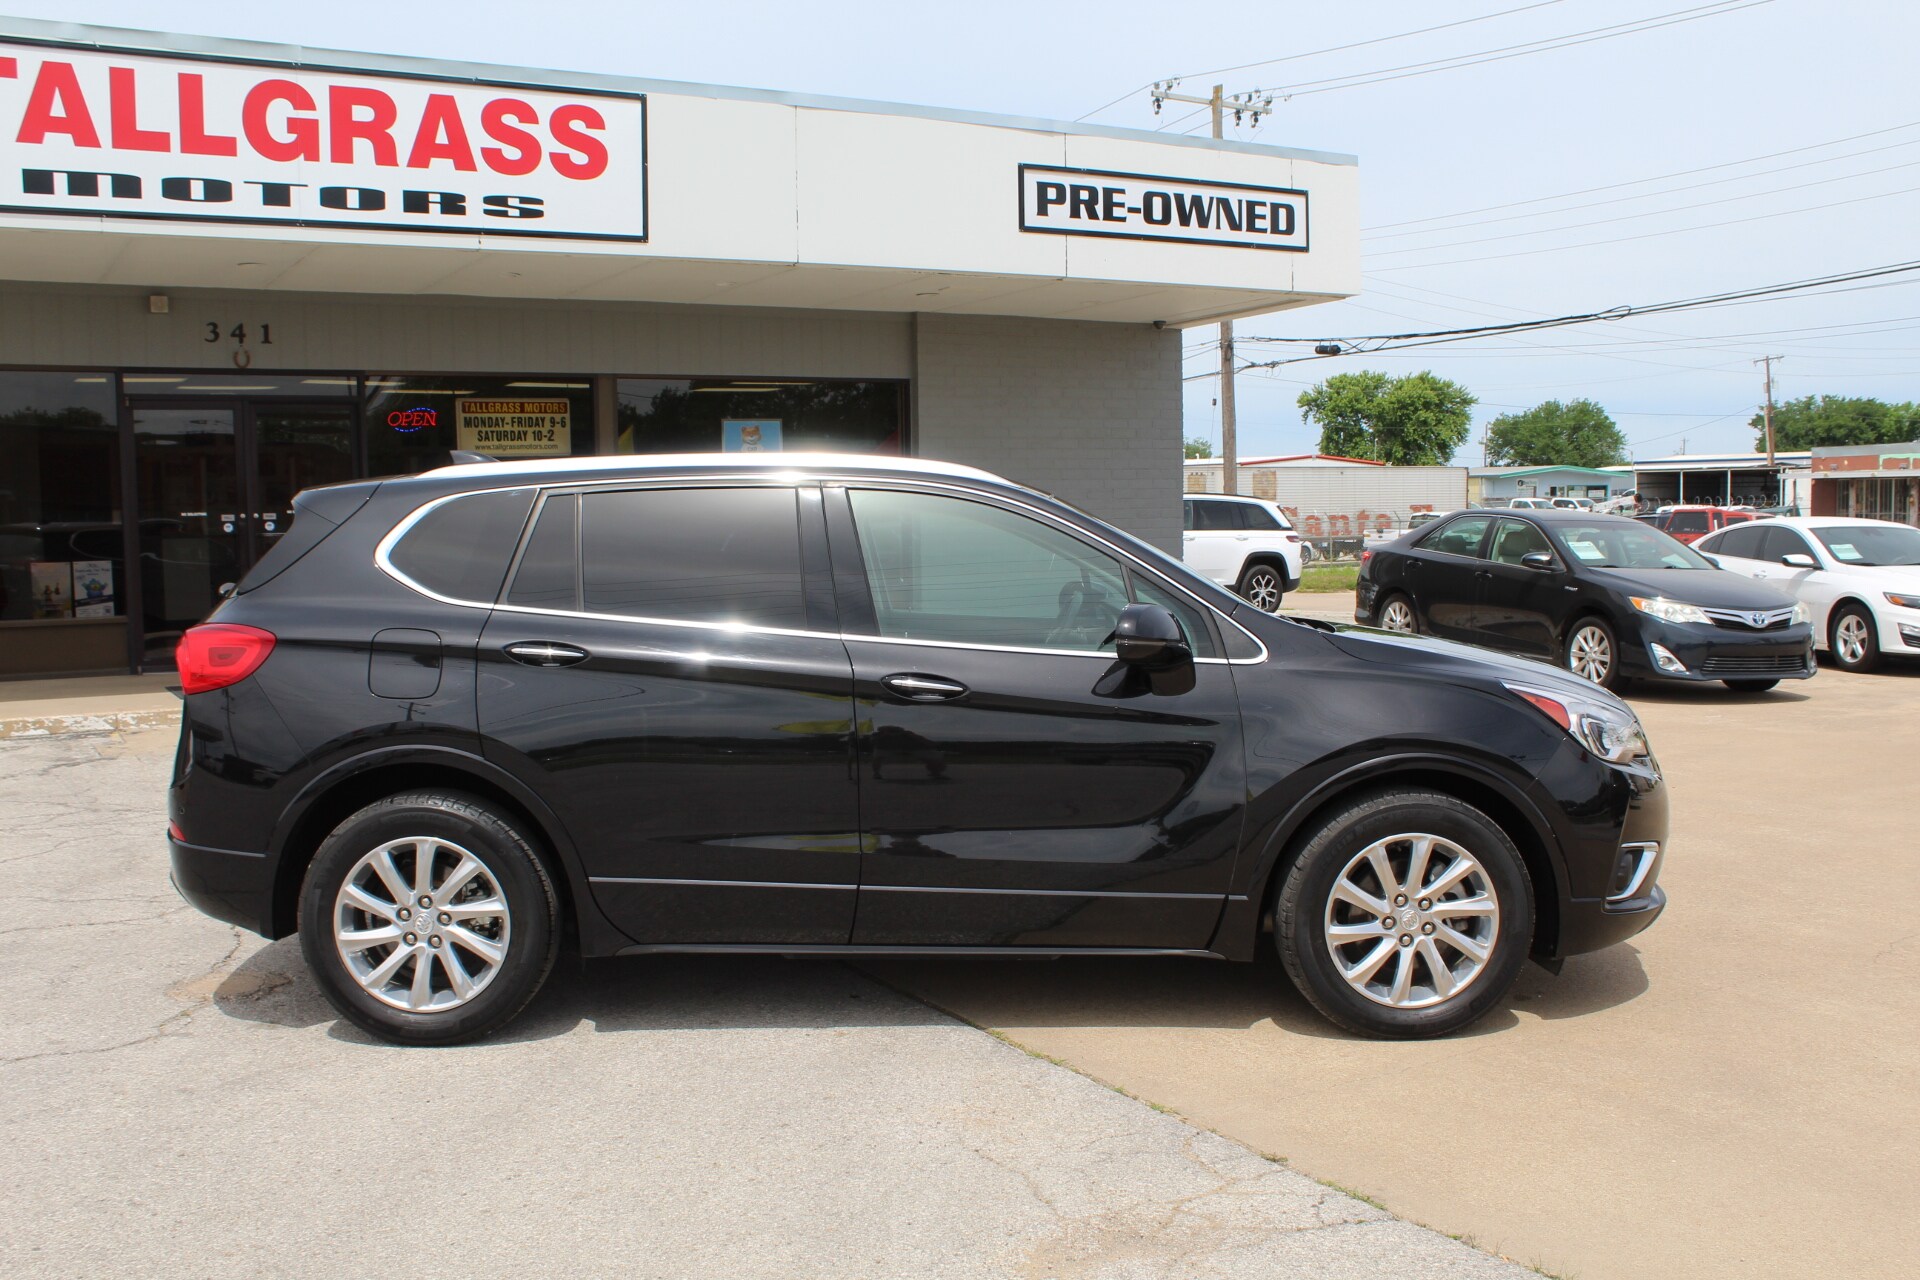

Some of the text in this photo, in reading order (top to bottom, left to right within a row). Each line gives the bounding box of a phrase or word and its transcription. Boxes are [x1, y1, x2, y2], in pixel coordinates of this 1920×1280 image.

[0, 57, 609, 181] ALLGRASS
[1036, 181, 1296, 237] PRE-OWNED
[464, 402, 566, 414] TALLGRASS MOTORS
[387, 411, 439, 427] OPEN
[463, 416, 567, 429] MONDAY-FRIDAY 9-6
[477, 430, 555, 442] SATURDAY 10-2
[474, 443, 559, 452] www.tallgrassmotors.com
